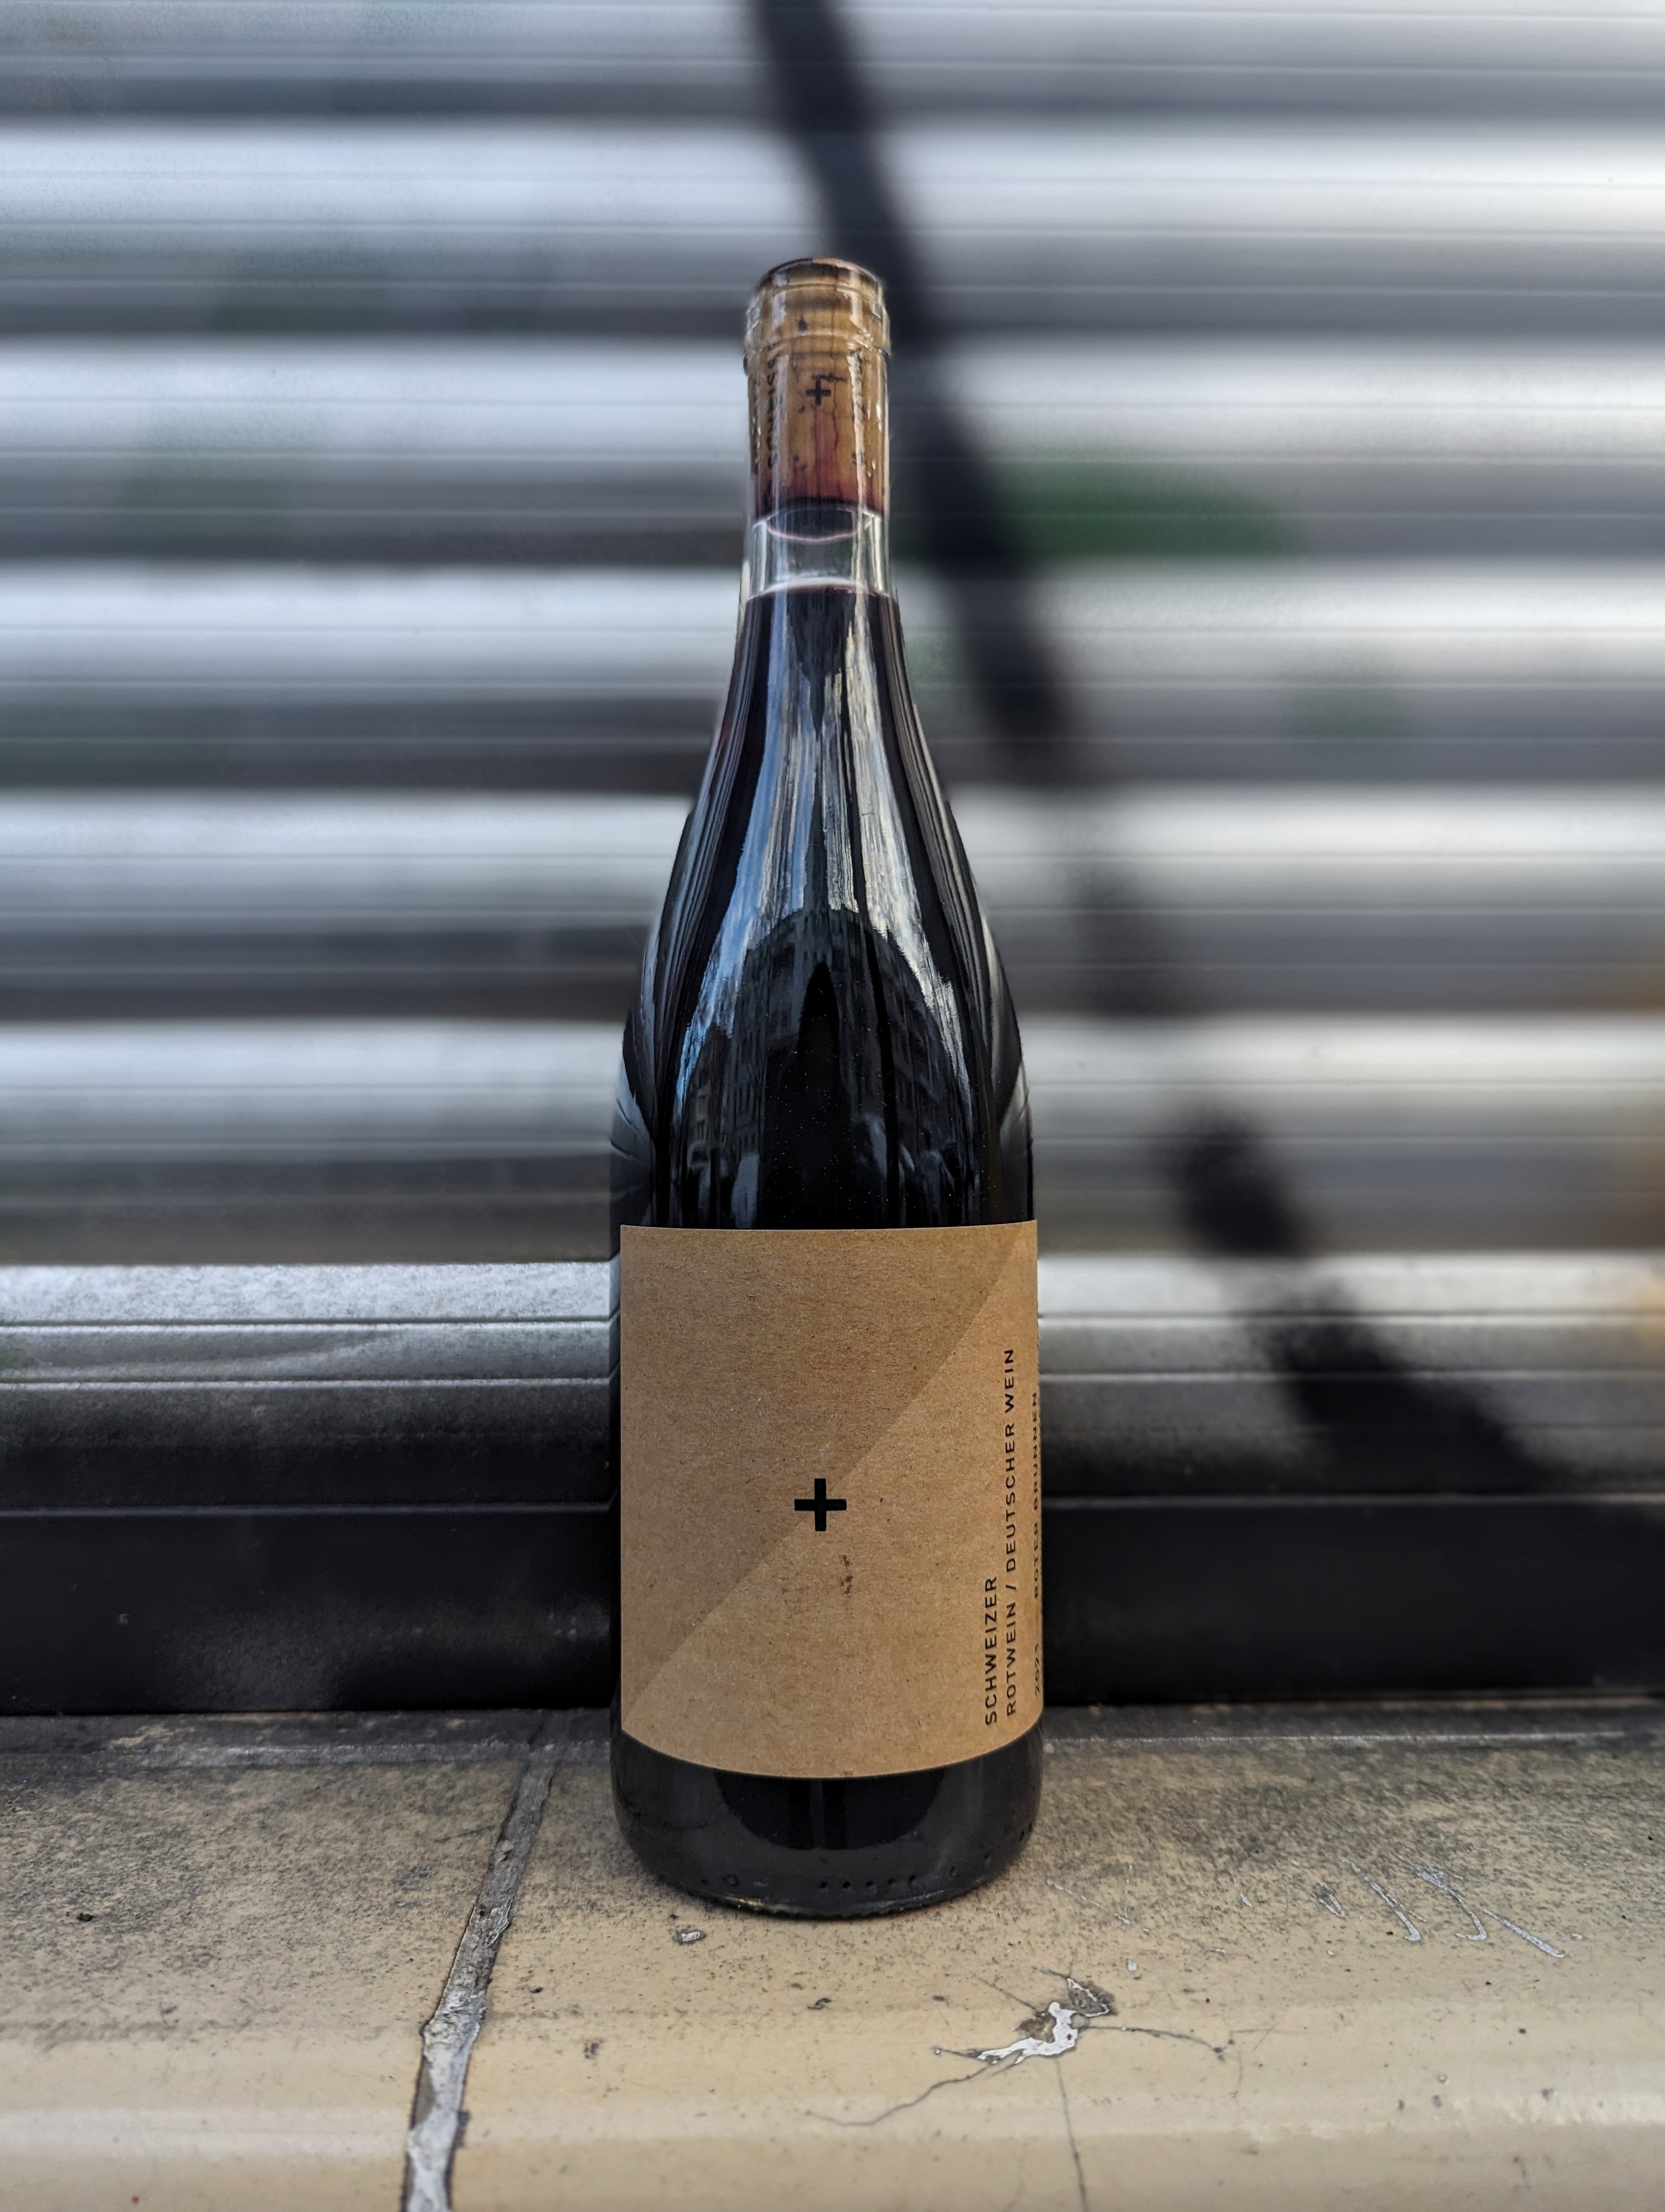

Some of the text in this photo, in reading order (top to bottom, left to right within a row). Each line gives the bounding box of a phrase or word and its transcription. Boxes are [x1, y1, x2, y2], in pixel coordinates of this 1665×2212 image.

[1004, 1348, 1014, 1412] WEIN
[1005, 1423, 1015, 1572] DEUTSCHER
[985, 1576, 997, 1725] SCHWEIZER
[1006, 1602, 1016, 1716] ROTWEIN
